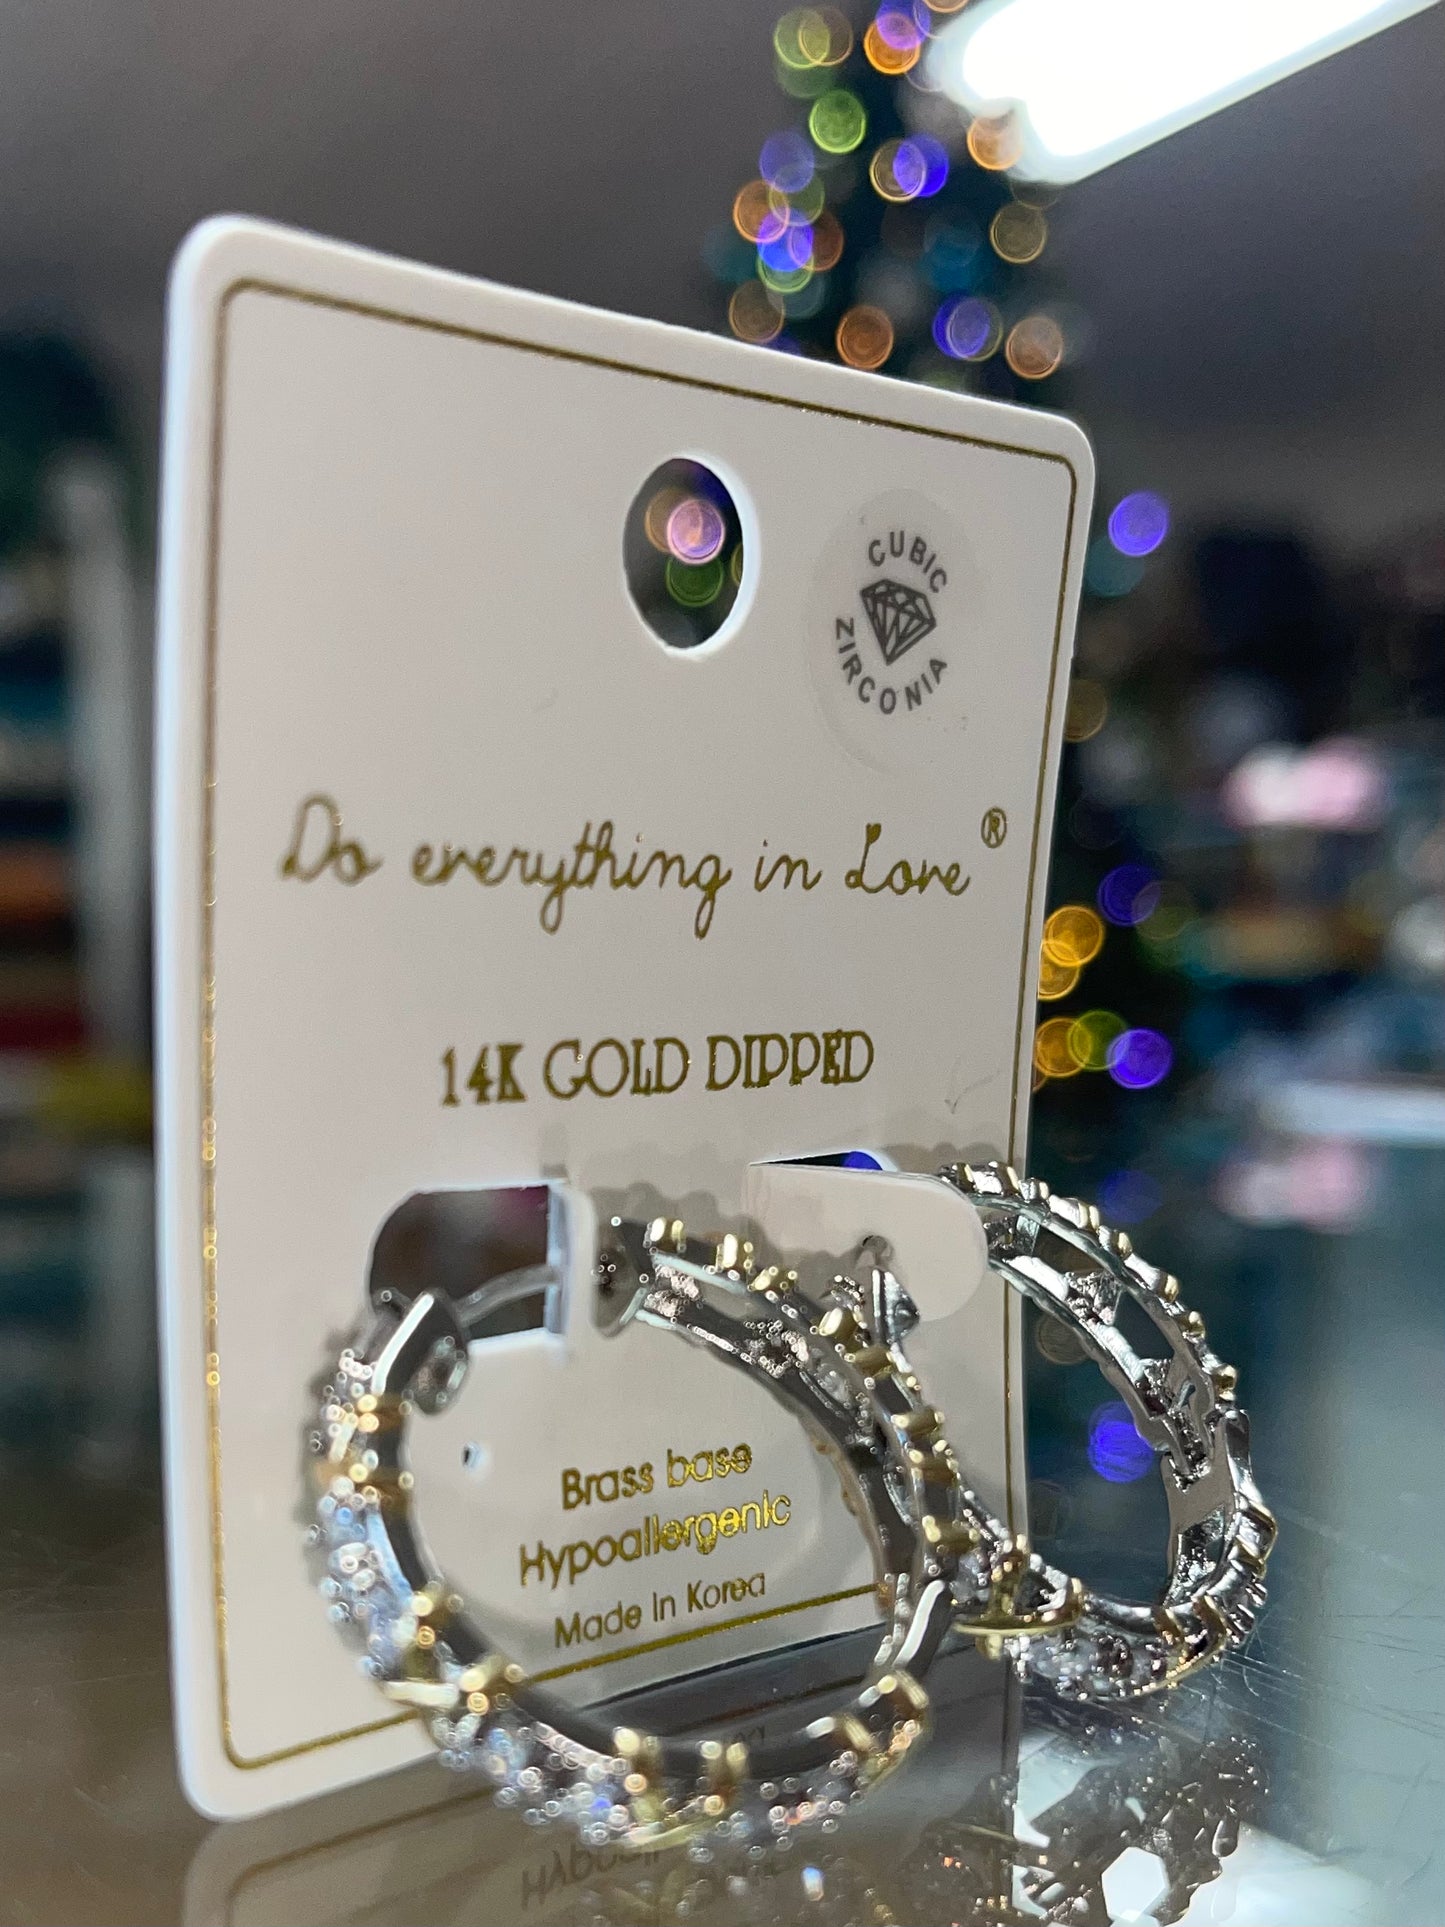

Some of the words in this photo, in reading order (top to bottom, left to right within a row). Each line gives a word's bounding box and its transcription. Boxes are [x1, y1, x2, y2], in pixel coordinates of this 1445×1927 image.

[867, 530, 947, 593] CUBIC
[836, 617, 948, 715] ZIRCONIA
[279, 791, 384, 886] Do
[411, 819, 733, 940] everything
[754, 838, 822, 892] in
[844, 822, 971, 896] Love
[441, 1041, 527, 1107] 14K
[543, 1035, 691, 1101] GOLD
[704, 1029, 874, 1091] DIPPED
[561, 1462, 654, 1511] Brass
[666, 1442, 752, 1488] base
[519, 1489, 792, 1590] Hypoallergenic
[554, 1600, 642, 1649] Made
[687, 1572, 766, 1613] Korea
